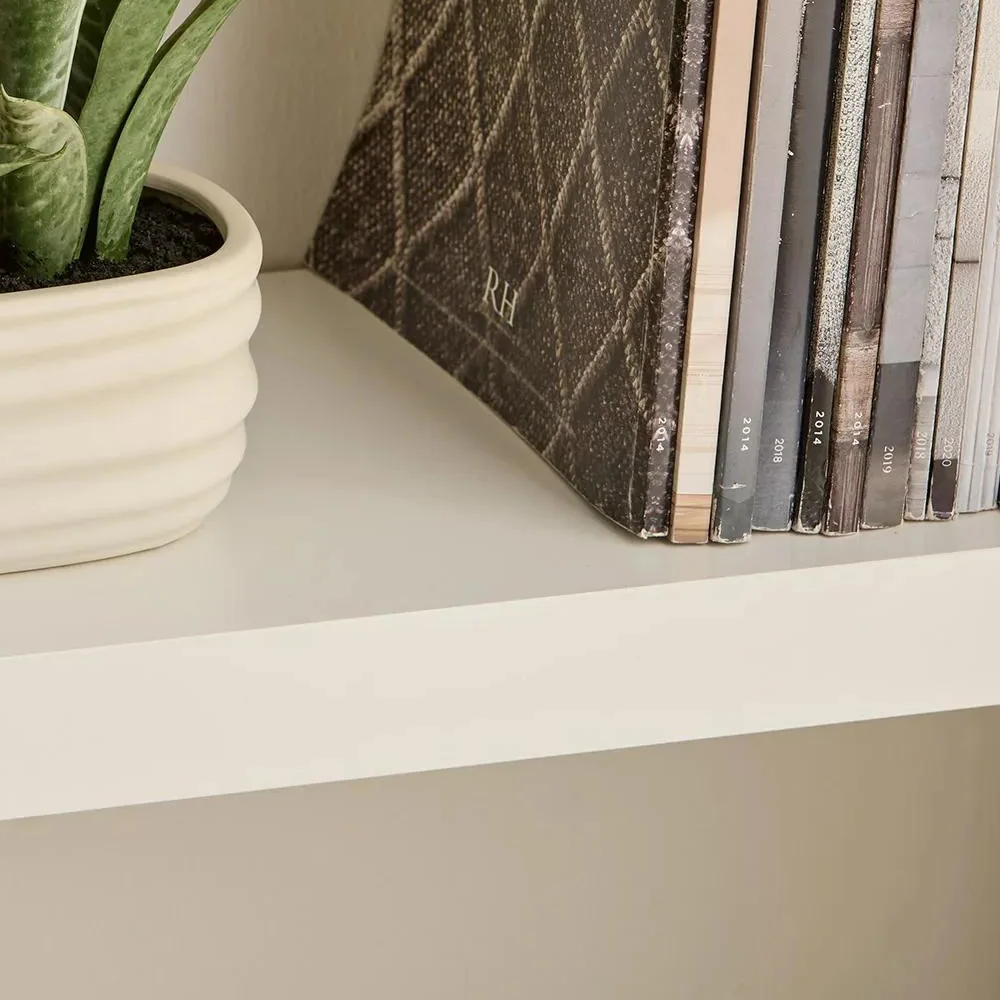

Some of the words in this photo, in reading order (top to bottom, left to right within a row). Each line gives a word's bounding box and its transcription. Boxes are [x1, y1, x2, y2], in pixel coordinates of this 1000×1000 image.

[482, 265, 518, 328] RH
[656, 417, 667, 451] 2014
[740, 417, 751, 452] 2014
[813, 411, 825, 446] 2014
[851, 411, 863, 446] 2014
[914, 432, 929, 459] 2018
[772, 438, 785, 463] 2018
[882, 446, 895, 474] 2019
[941, 438, 955, 467] 2020
